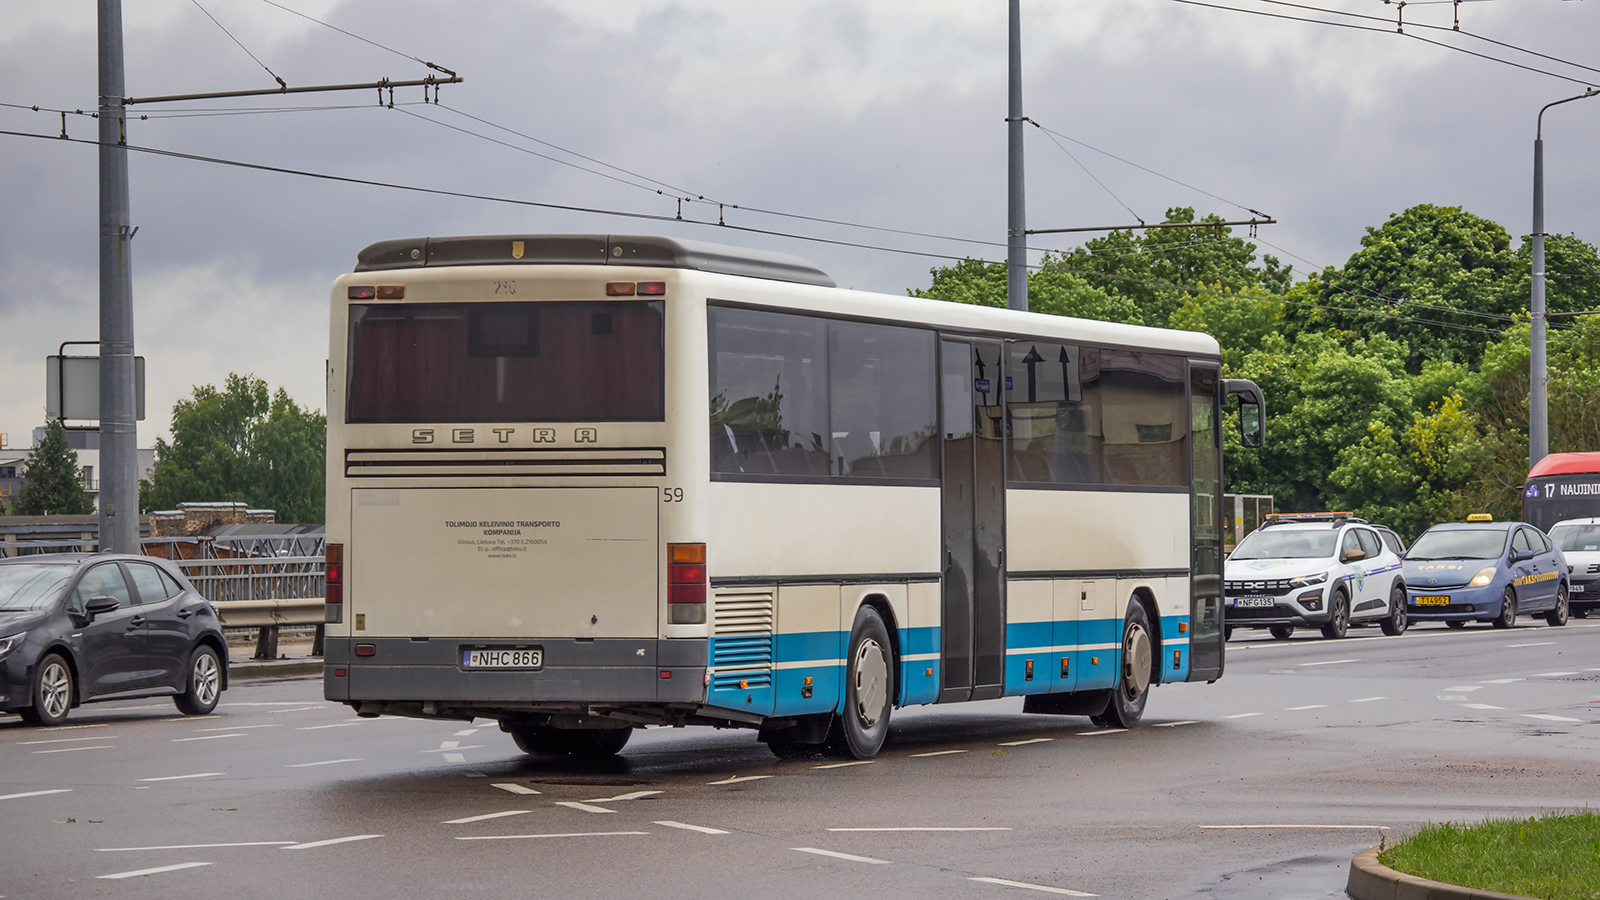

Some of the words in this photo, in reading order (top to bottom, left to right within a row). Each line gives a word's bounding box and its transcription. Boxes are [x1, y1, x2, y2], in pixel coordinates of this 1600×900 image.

[412, 428, 597, 444] SETRA
[663, 487, 684, 503] 59
[1544, 483, 1556, 498] 17
[479, 651, 540, 666] NHC866
